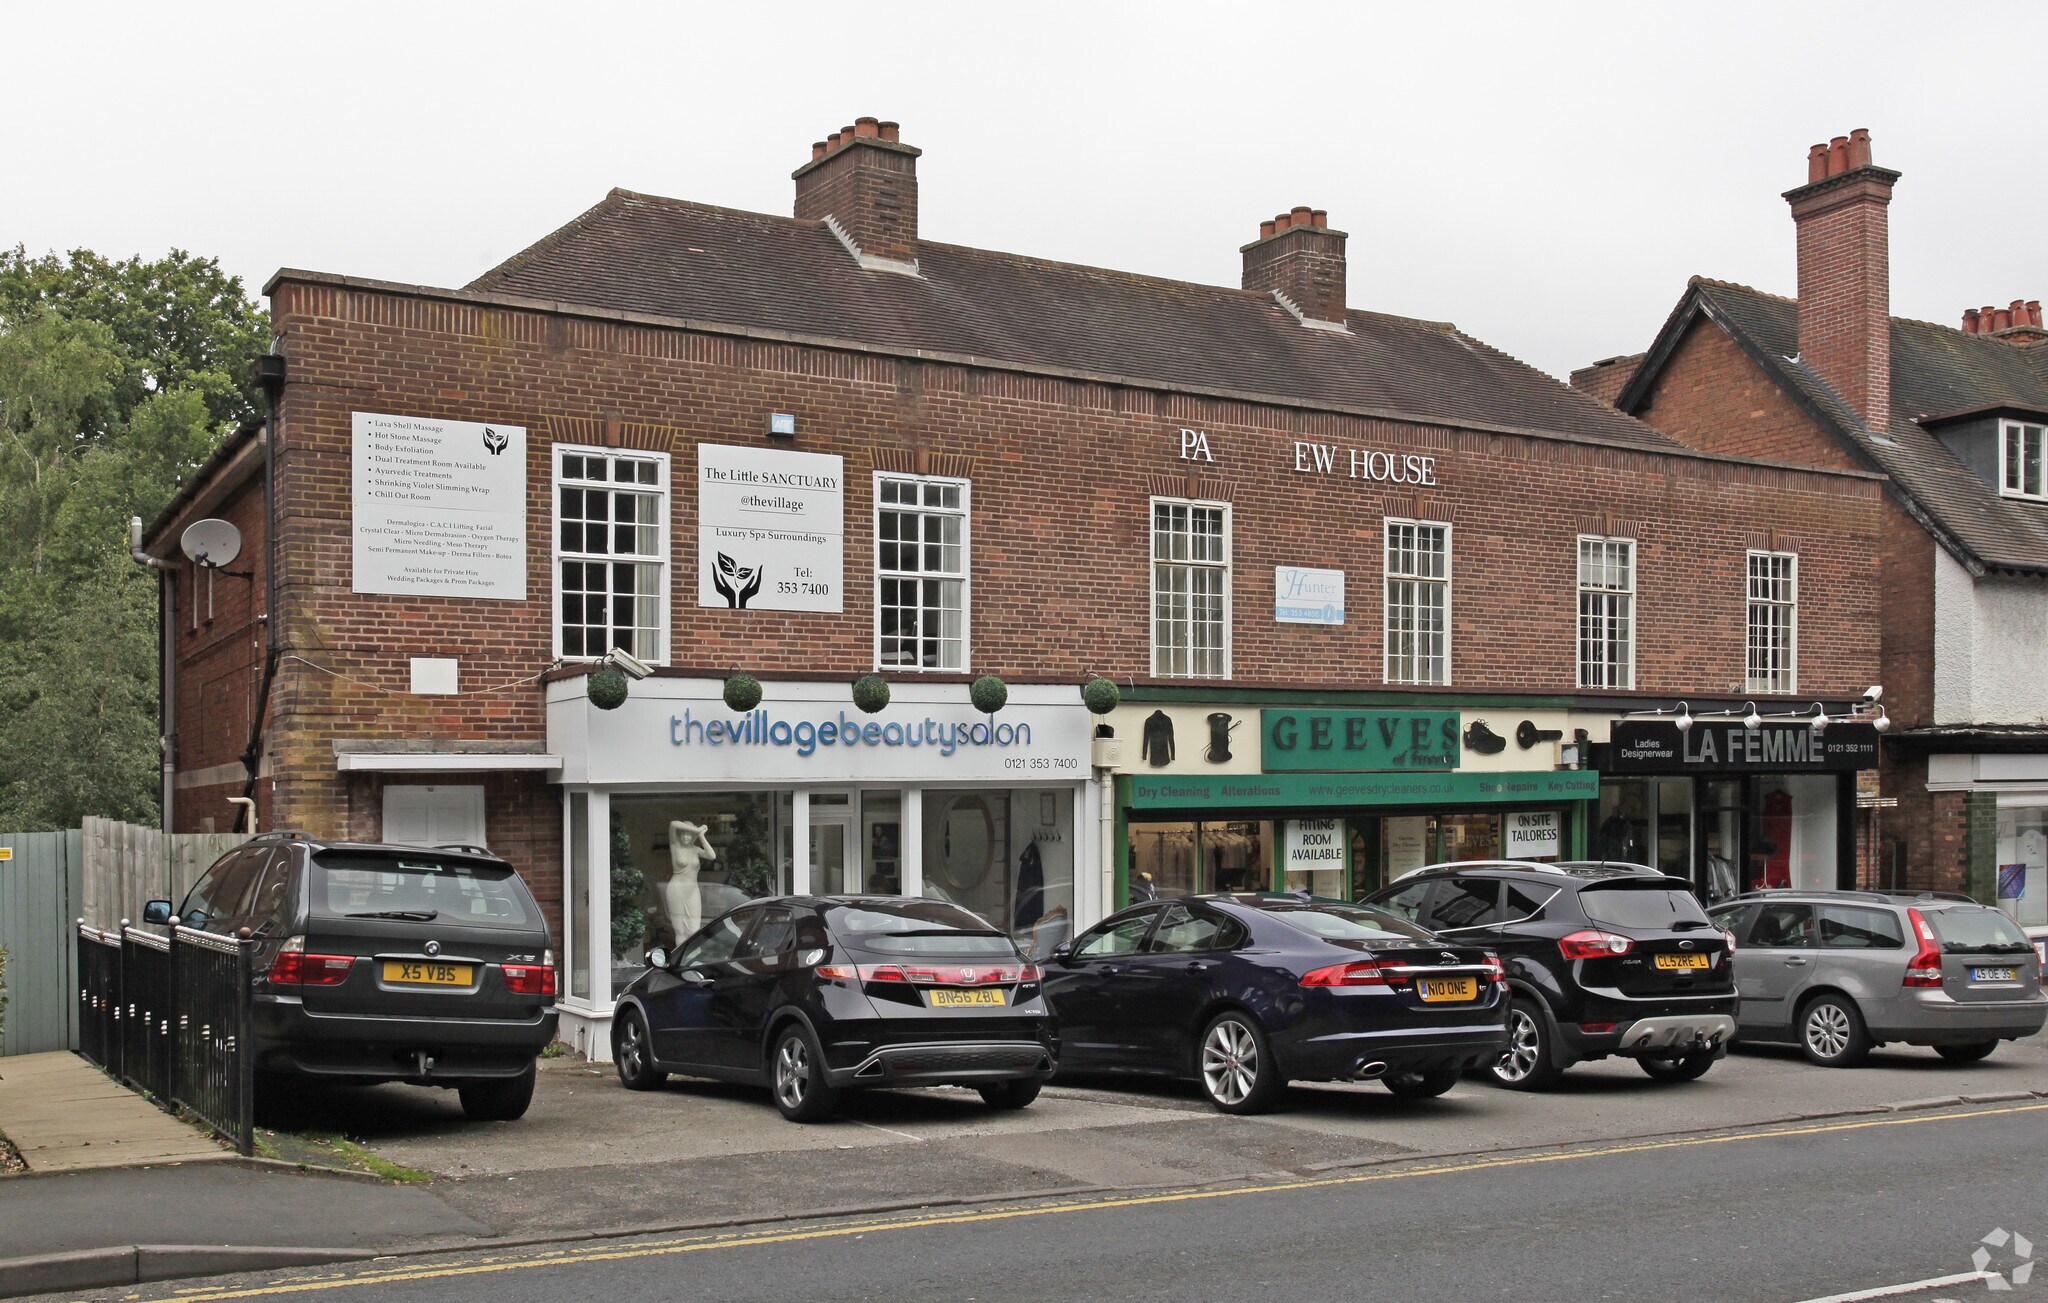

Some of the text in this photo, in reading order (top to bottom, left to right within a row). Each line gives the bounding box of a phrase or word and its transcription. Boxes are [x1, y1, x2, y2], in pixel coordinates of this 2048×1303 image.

[414, 424, 443, 433] Massage
[413, 435, 442, 445] Massage
[1180, 428, 1214, 462] PA
[396, 446, 434, 454] Exfoliation
[395, 457, 430, 466] Treatment
[454, 462, 486, 470] Available
[1294, 441, 1436, 486] EW HOUSE
[375, 468, 452, 479] Ayurvedic Treatments
[705, 467, 837, 488] The Little SANCTUARY
[375, 479, 411, 489] Shrinking
[436, 484, 469, 493] Slimming
[471, 487, 490, 495] Wrap
[741, 495, 804, 512] @thevillage
[387, 519, 425, 528] Dermalogica
[716, 528, 827, 545] Luxury Spa Surroundings
[794, 568, 812, 577] Tel:
[387, 575, 414, 583] Wedding
[1281, 570, 1336, 600] Hunter
[777, 582, 828, 595] 353 7400
[670, 708, 1032, 756] thevillagebeautysalon
[1272, 716, 1458, 750] GEEVES
[1635, 739, 1660, 749] Ladies
[1683, 729, 1824, 763] LA FEMME
[1828, 744, 1874, 753] 0121 352 1111
[1622, 748, 1674, 759] Designerwear
[1004, 758, 1077, 769] 0121 353 7400
[1221, 785, 1280, 797] Alterations
[1308, 783, 1454, 798] www.geevesdrycleaners.co.uk
[1548, 780, 1596, 792] Key Cutting
[1138, 786, 1210, 800] Dry Cleaning
[1300, 819, 1334, 830] FITTING
[1518, 814, 1551, 826] ON SITE
[1303, 834, 1331, 845] ROOM
[1512, 829, 1556, 841] TAILORESS
[1292, 849, 1342, 860] AVAILABLE
[1657, 956, 1694, 967] CL52RE
[401, 962, 456, 981] X5 VBS
[1977, 968, 1986, 979] 45
[2002, 968, 2012, 979] 35
[1448, 982, 1467, 995] ONE
[936, 990, 999, 1003] BN56 ZBL
